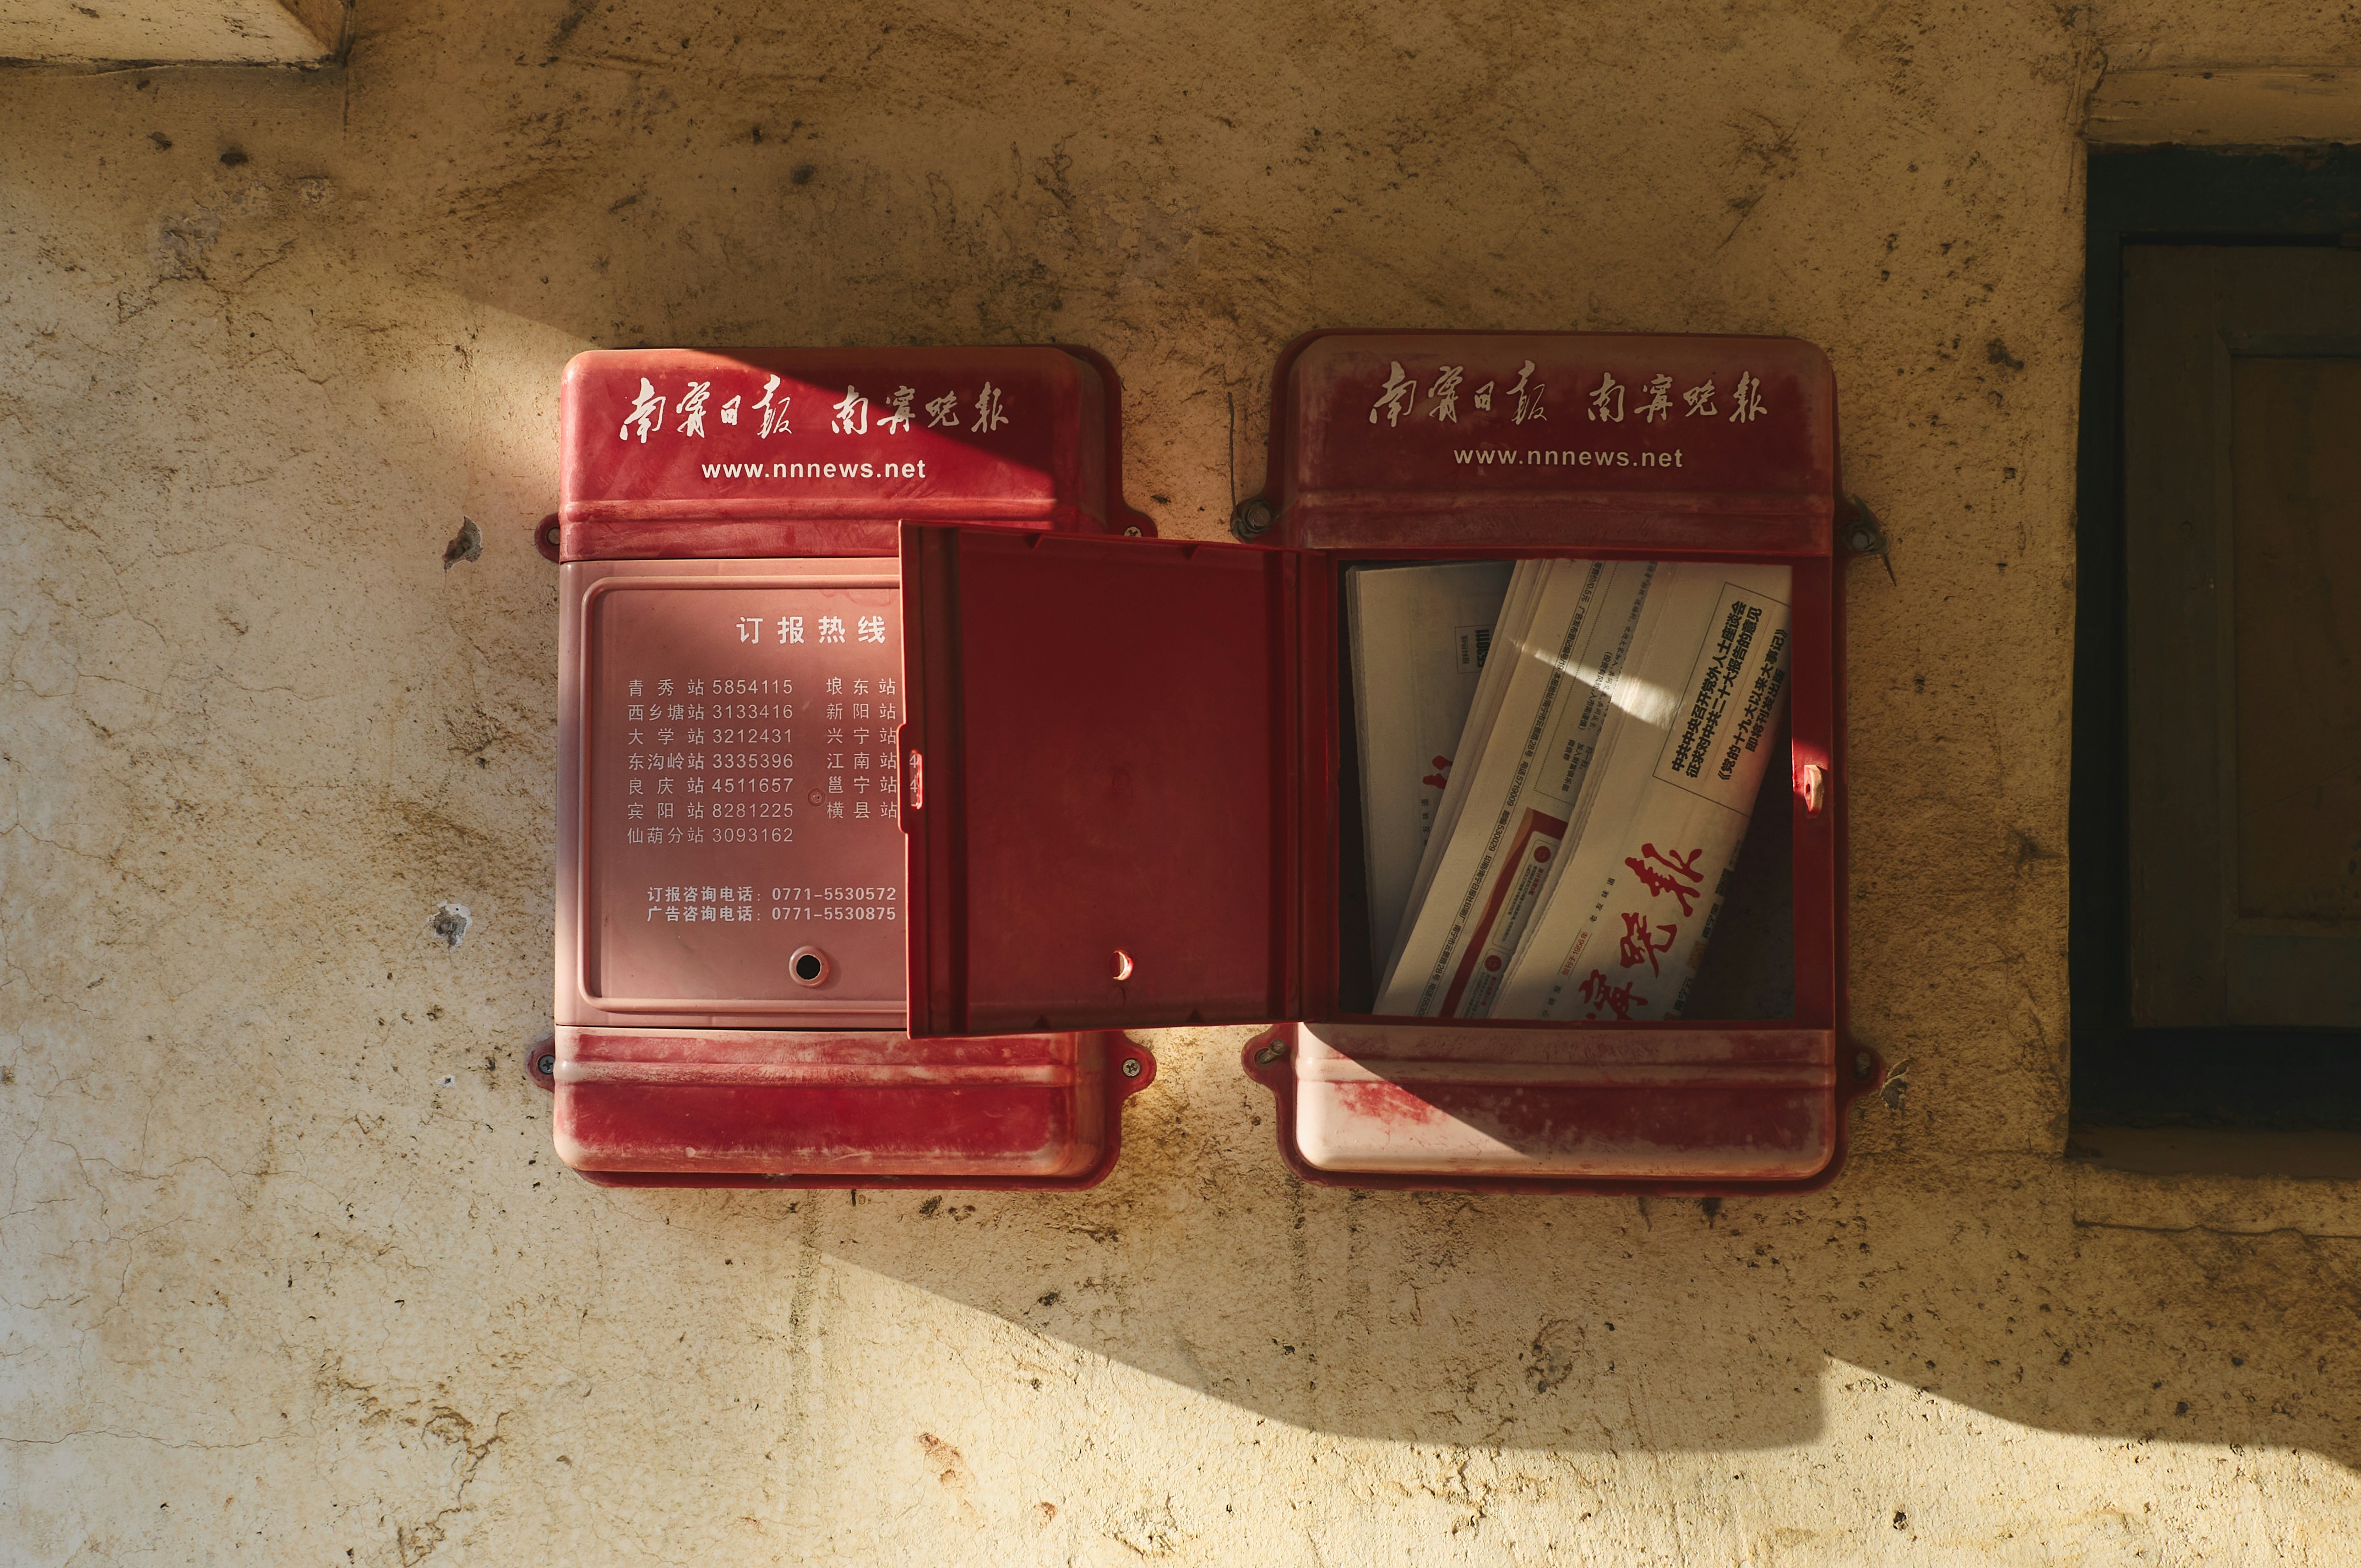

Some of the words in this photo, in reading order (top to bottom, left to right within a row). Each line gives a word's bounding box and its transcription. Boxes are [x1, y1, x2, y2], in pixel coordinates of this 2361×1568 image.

[1454, 449, 1683, 467] www.nnnews.net
[701, 460, 926, 478] www.nnnews.net
[736, 616, 885, 644] 订报热线
[628, 678, 704, 697] 青秀站
[712, 679, 792, 694] 5854115
[1671, 600, 1747, 773] 中共中央召开党外人士座谈会
[1685, 606, 1762, 778] 征求对中共二十大报告的意见
[628, 703, 704, 721] 西乡塘站
[712, 704, 793, 719] 3133416
[1717, 628, 1788, 781] 《党的十九大以来大事记》
[1745, 668, 1785, 752] 即将刊发出版
[628, 727, 705, 745] 大学站
[713, 728, 791, 743] 3212431
[628, 752, 705, 771] 东沟岭站
[712, 753, 793, 769] 3335396
[629, 777, 704, 795] 良庆站
[711, 778, 793, 793] 4511657
[628, 802, 704, 820] 宾阳站
[712, 803, 793, 818] 8281225
[627, 826, 704, 844] 仙葫分站
[712, 827, 793, 842] 3093162
[772, 887, 896, 900] 0771-5530572
[772, 907, 896, 920] 0771-5530875
[1560, 930, 1590, 976] 创刊于1956年
